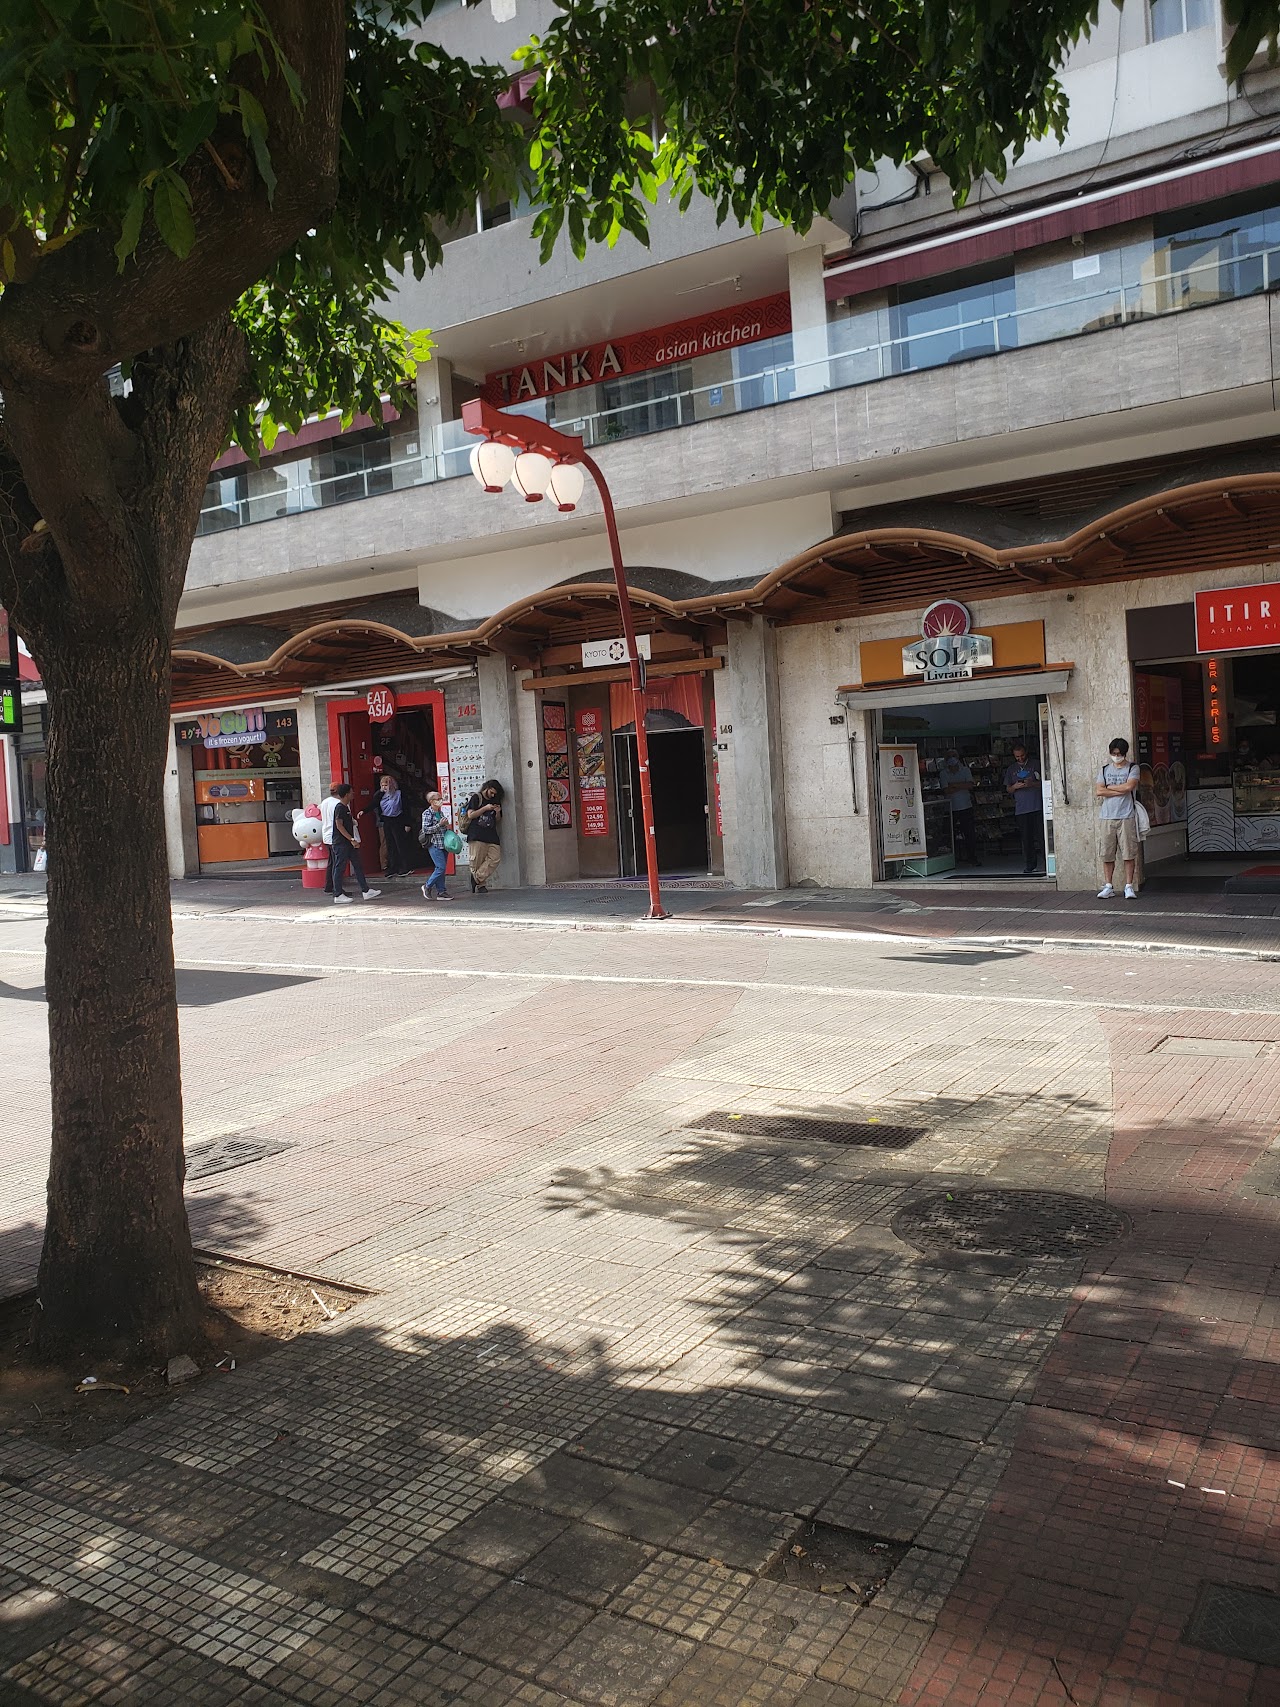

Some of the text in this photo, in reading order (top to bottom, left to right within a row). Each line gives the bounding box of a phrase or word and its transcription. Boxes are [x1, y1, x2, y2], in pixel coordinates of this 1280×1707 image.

[655, 323, 761, 362] asian kitchen
[496, 344, 622, 402] TANKA
[1209, 601, 1271, 623] ITIR
[1211, 625, 1252, 635] ASIAN
[584, 649, 607, 659] KYOTO
[915, 646, 968, 670] SOL
[927, 670, 970, 680] Livraria
[1210, 684, 1218, 693] &
[366, 690, 388, 705] EAT
[368, 703, 394, 717] ASIA
[457, 703, 477, 718] 145
[276, 717, 293, 728] 143
[829, 715, 845, 726] 153
[1210, 699, 1220, 744] FRIES
[208, 733, 262, 746] it's frozen yogurt!
[380, 737, 391, 746] 2F
